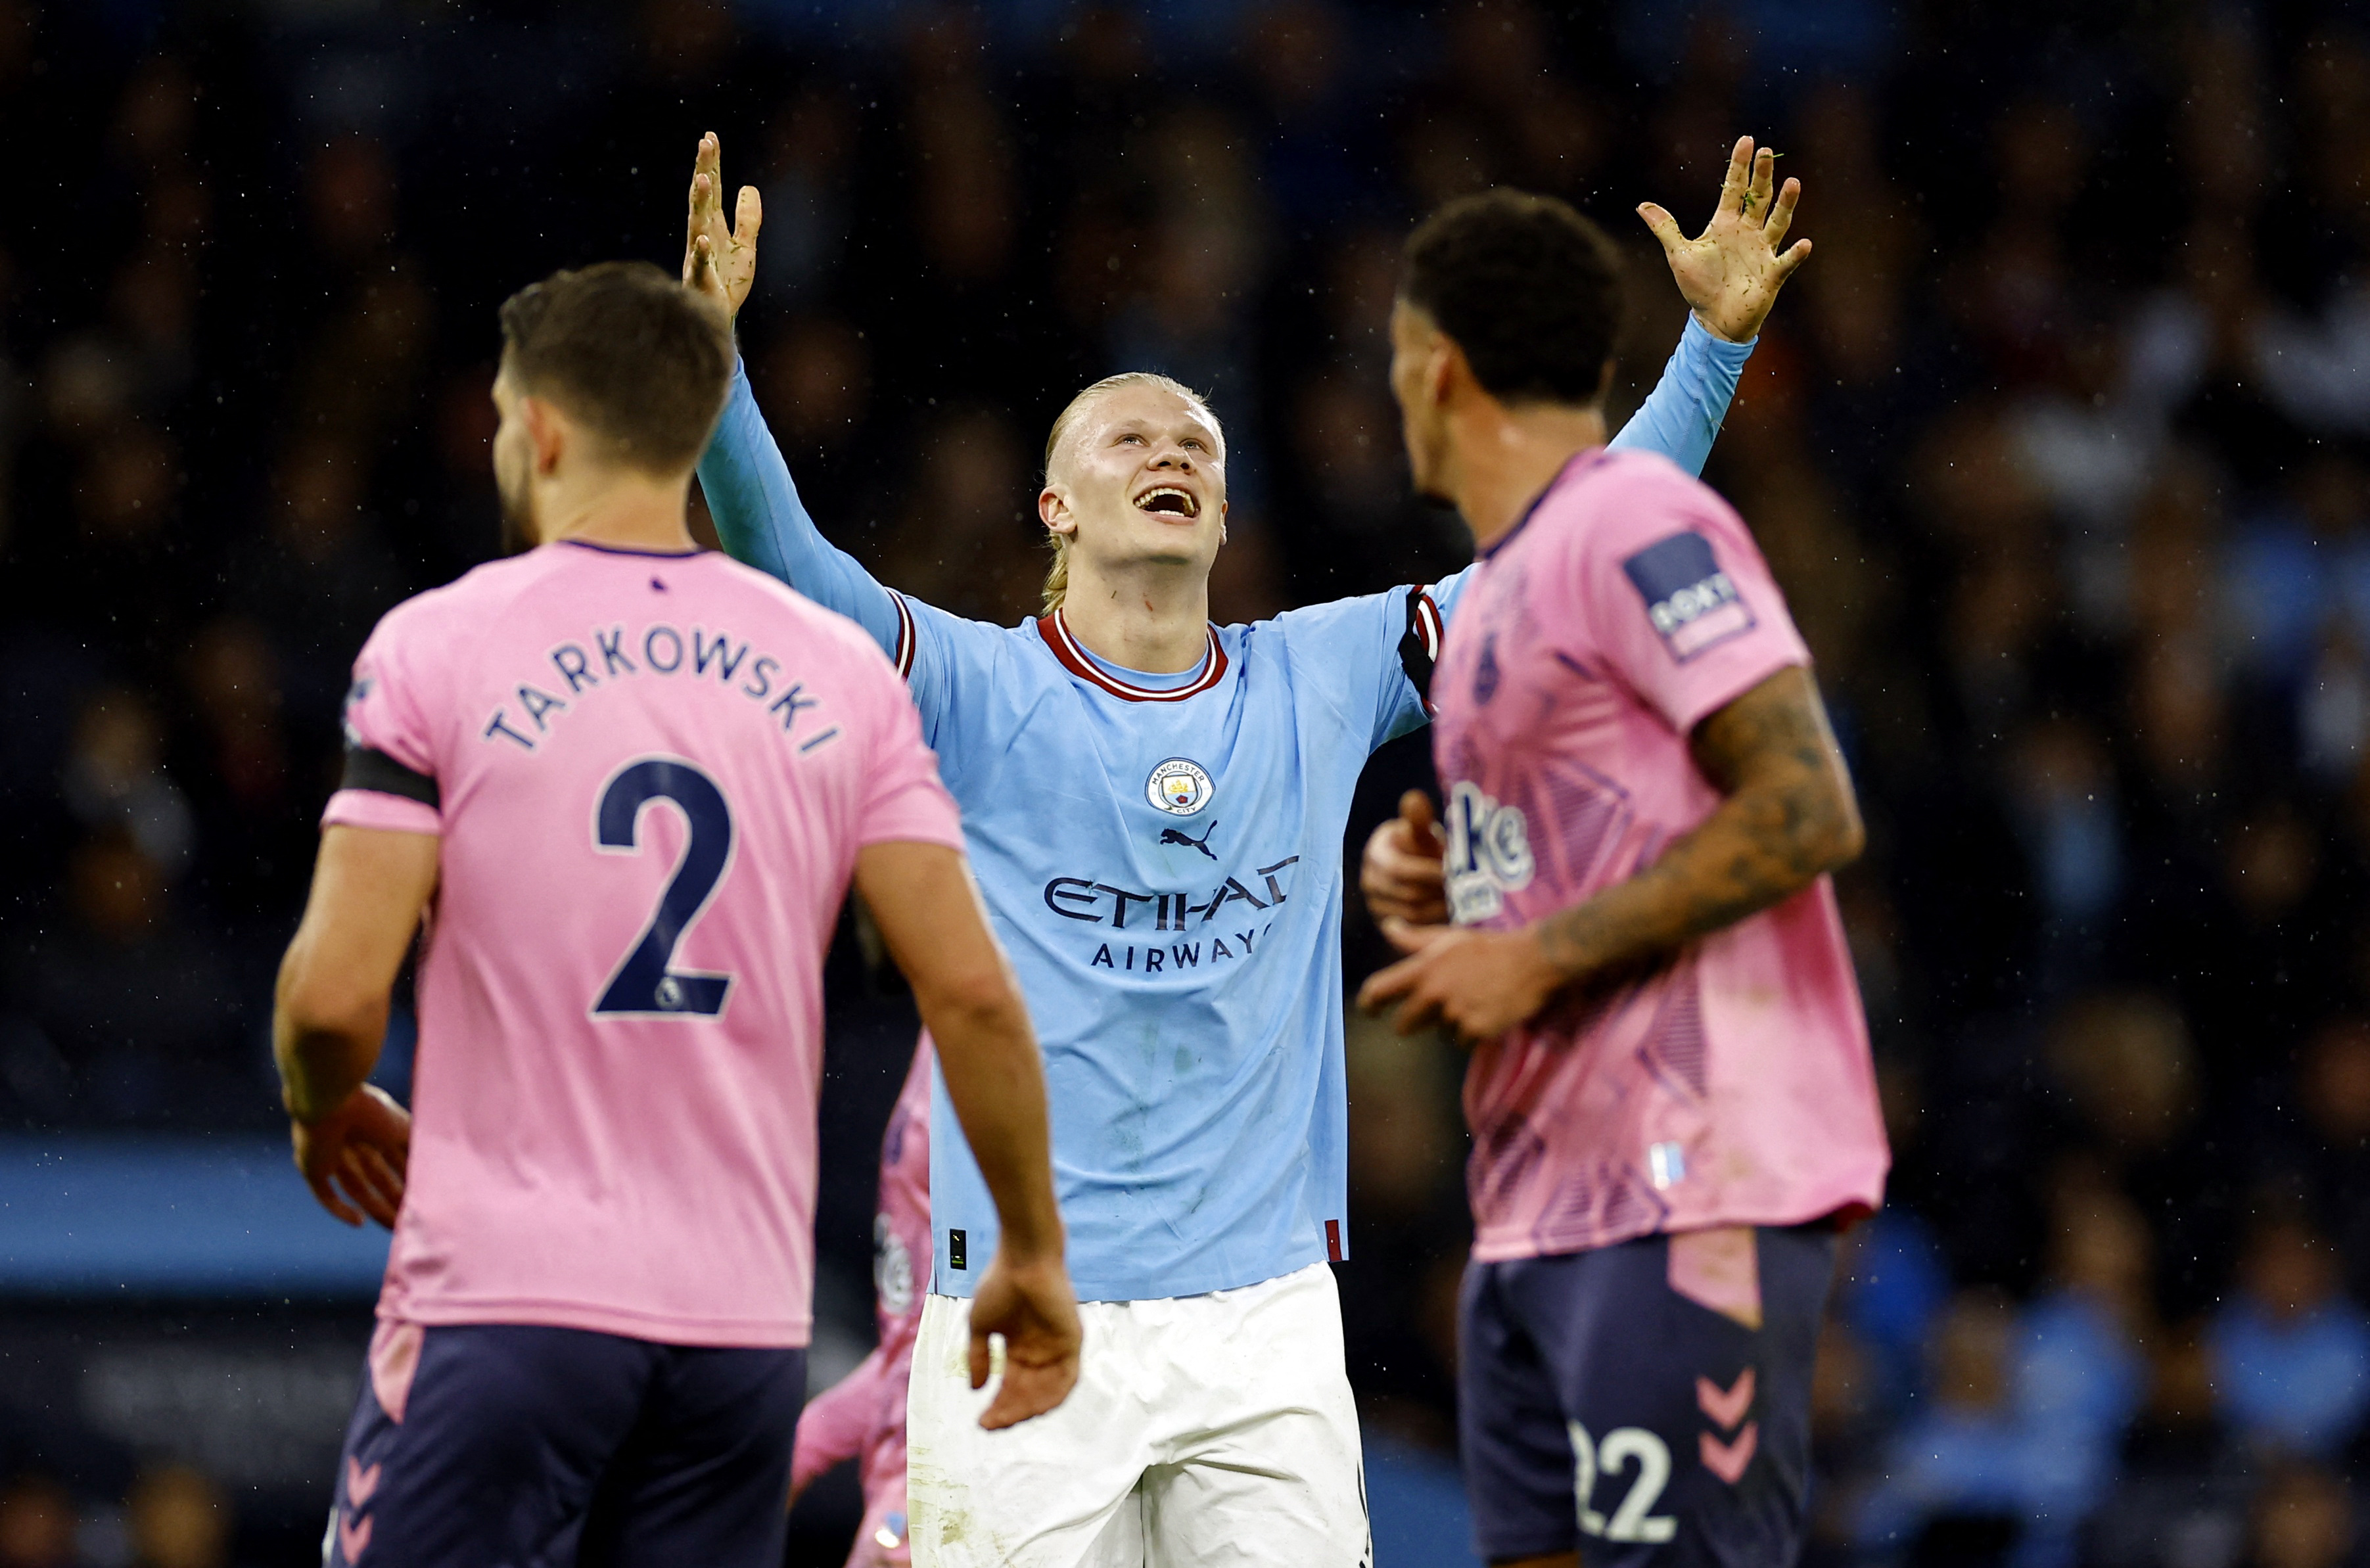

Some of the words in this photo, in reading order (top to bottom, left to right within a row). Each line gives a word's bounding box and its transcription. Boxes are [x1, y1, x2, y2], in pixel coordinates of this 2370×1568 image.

[484, 626, 838, 753] TARKOWSKI
[1151, 763, 1205, 785] MANCHESTER
[588, 754, 737, 1020] 2
[1090, 923, 1272, 973] AIRWAY
